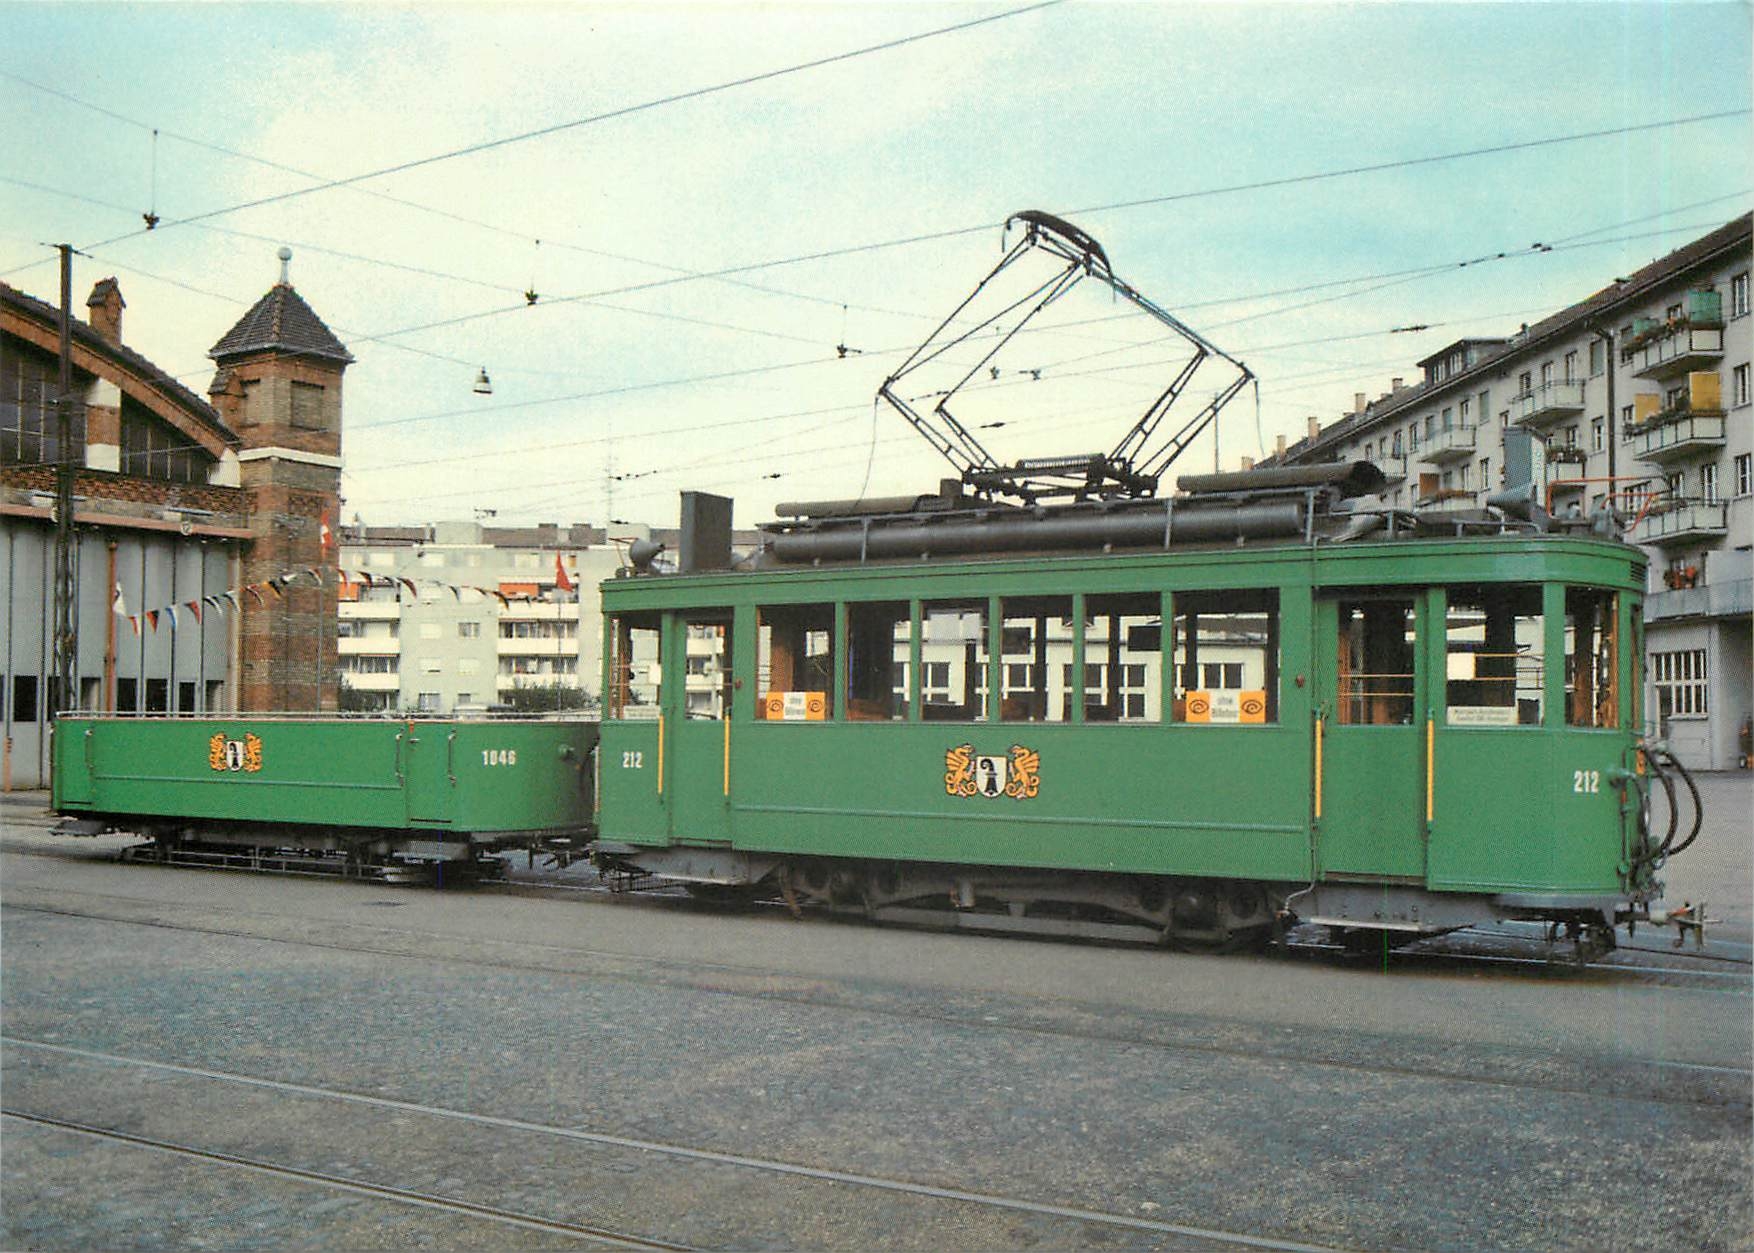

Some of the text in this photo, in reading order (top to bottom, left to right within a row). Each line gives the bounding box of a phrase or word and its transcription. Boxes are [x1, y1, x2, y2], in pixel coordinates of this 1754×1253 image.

[482, 750, 516, 766] 1046
[623, 751, 643, 769] 212
[1574, 770, 1599, 793] 212
